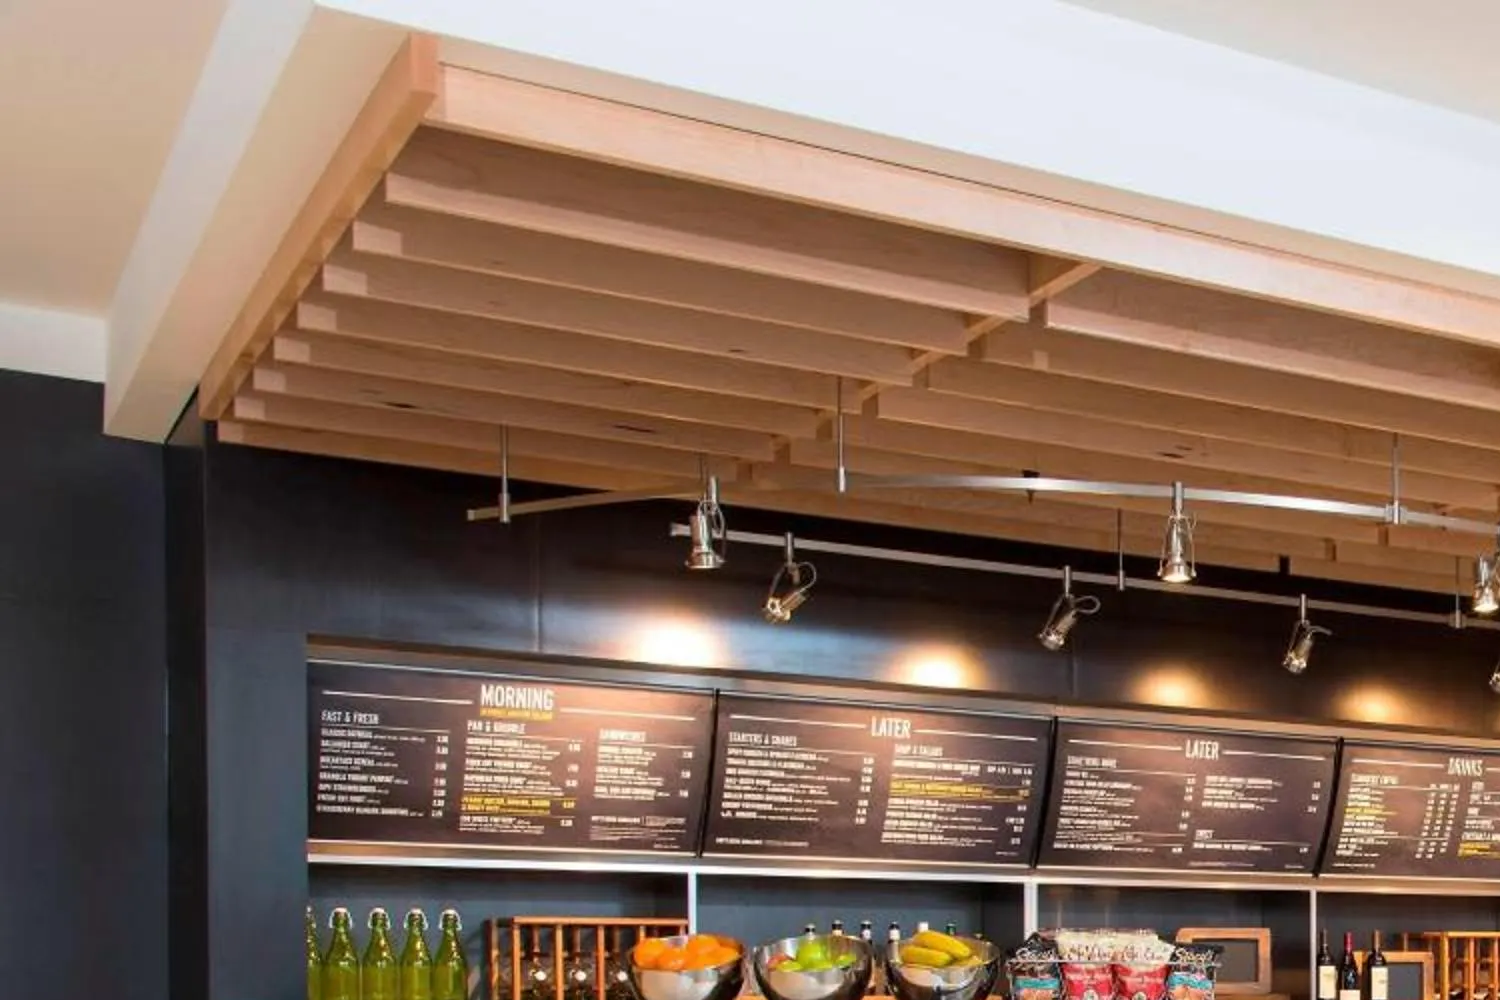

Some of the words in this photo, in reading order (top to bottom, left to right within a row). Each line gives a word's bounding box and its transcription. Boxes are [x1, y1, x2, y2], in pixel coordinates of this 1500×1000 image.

[480, 684, 554, 711] MORNING
[320, 710, 343, 723] FAST
[871, 715, 912, 739] LATER
[1185, 739, 1220, 761] LATER
